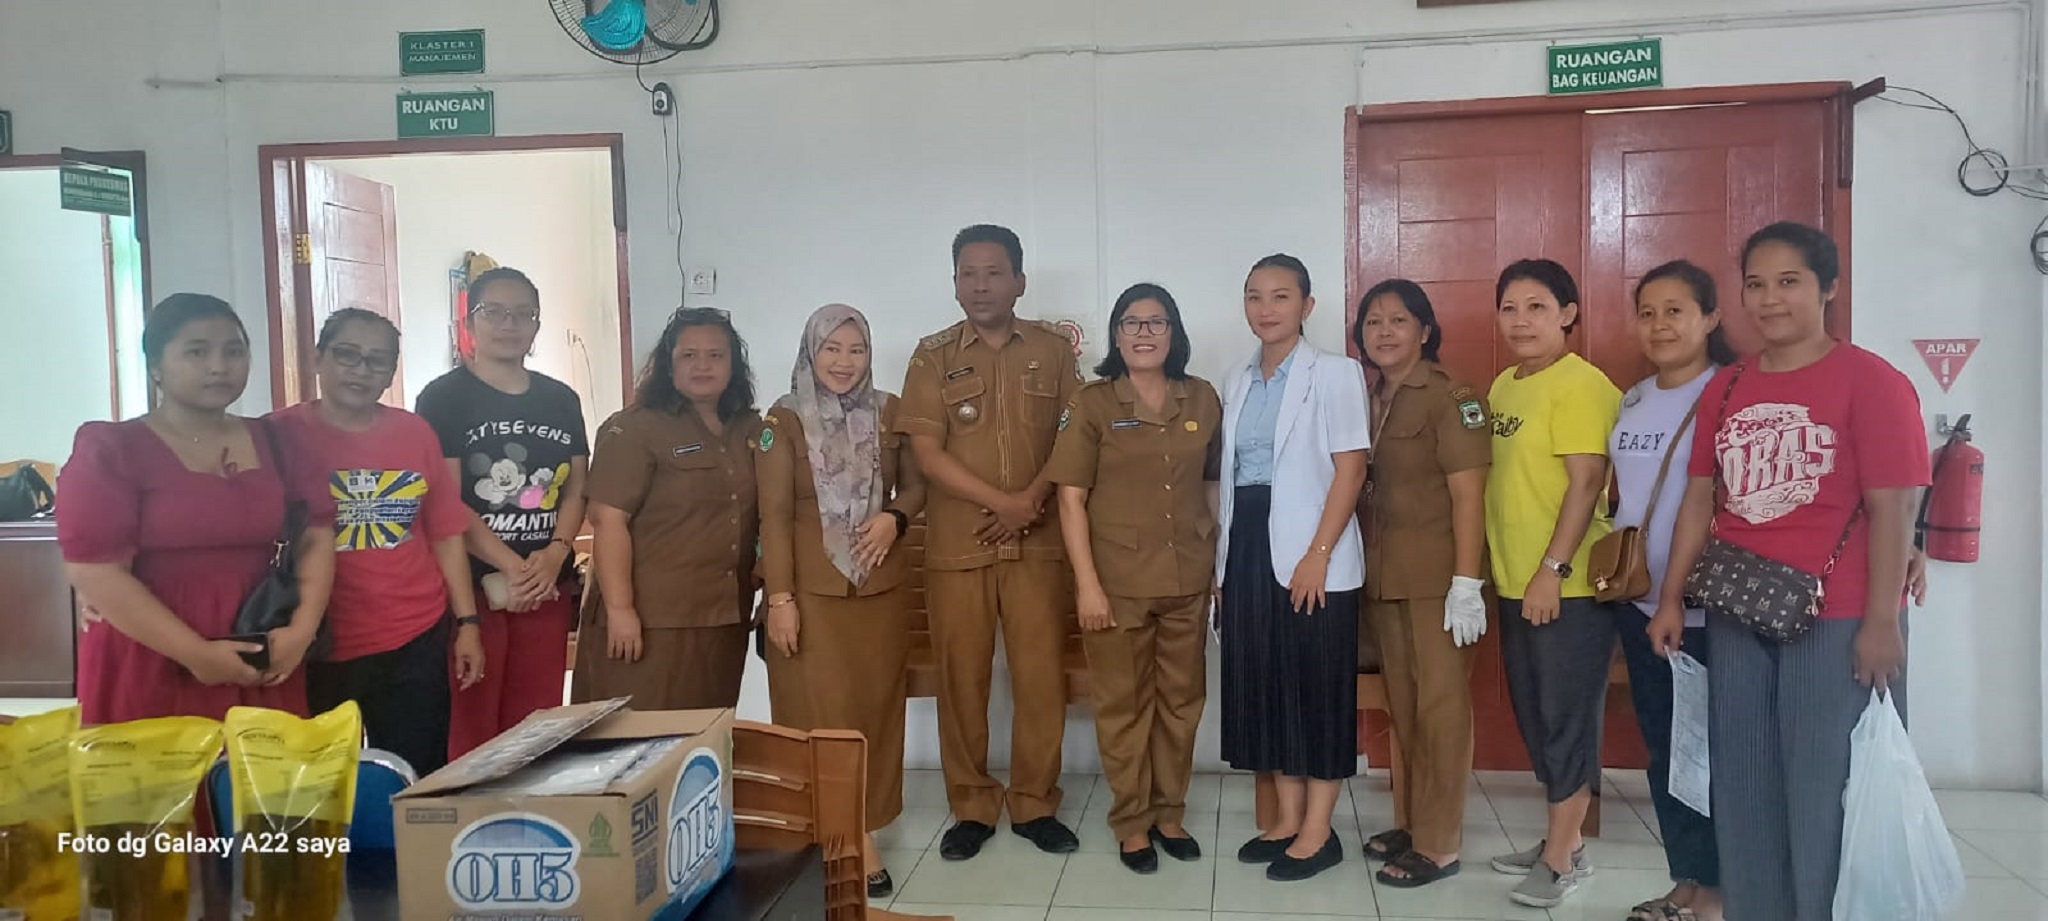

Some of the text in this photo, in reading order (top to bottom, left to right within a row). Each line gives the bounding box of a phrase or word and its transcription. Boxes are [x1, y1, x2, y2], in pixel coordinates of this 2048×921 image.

[410, 41, 466, 50] KLASTER
[409, 53, 476, 62] MANAJEMEN
[1556, 47, 1652, 68] RUANGAN
[1552, 67, 1658, 88] BAG KEUANGAN
[402, 98, 485, 114] RUANGAN
[429, 117, 458, 130] KTU
[1925, 343, 1967, 355] APAR
[1618, 431, 1665, 451] EAZY
